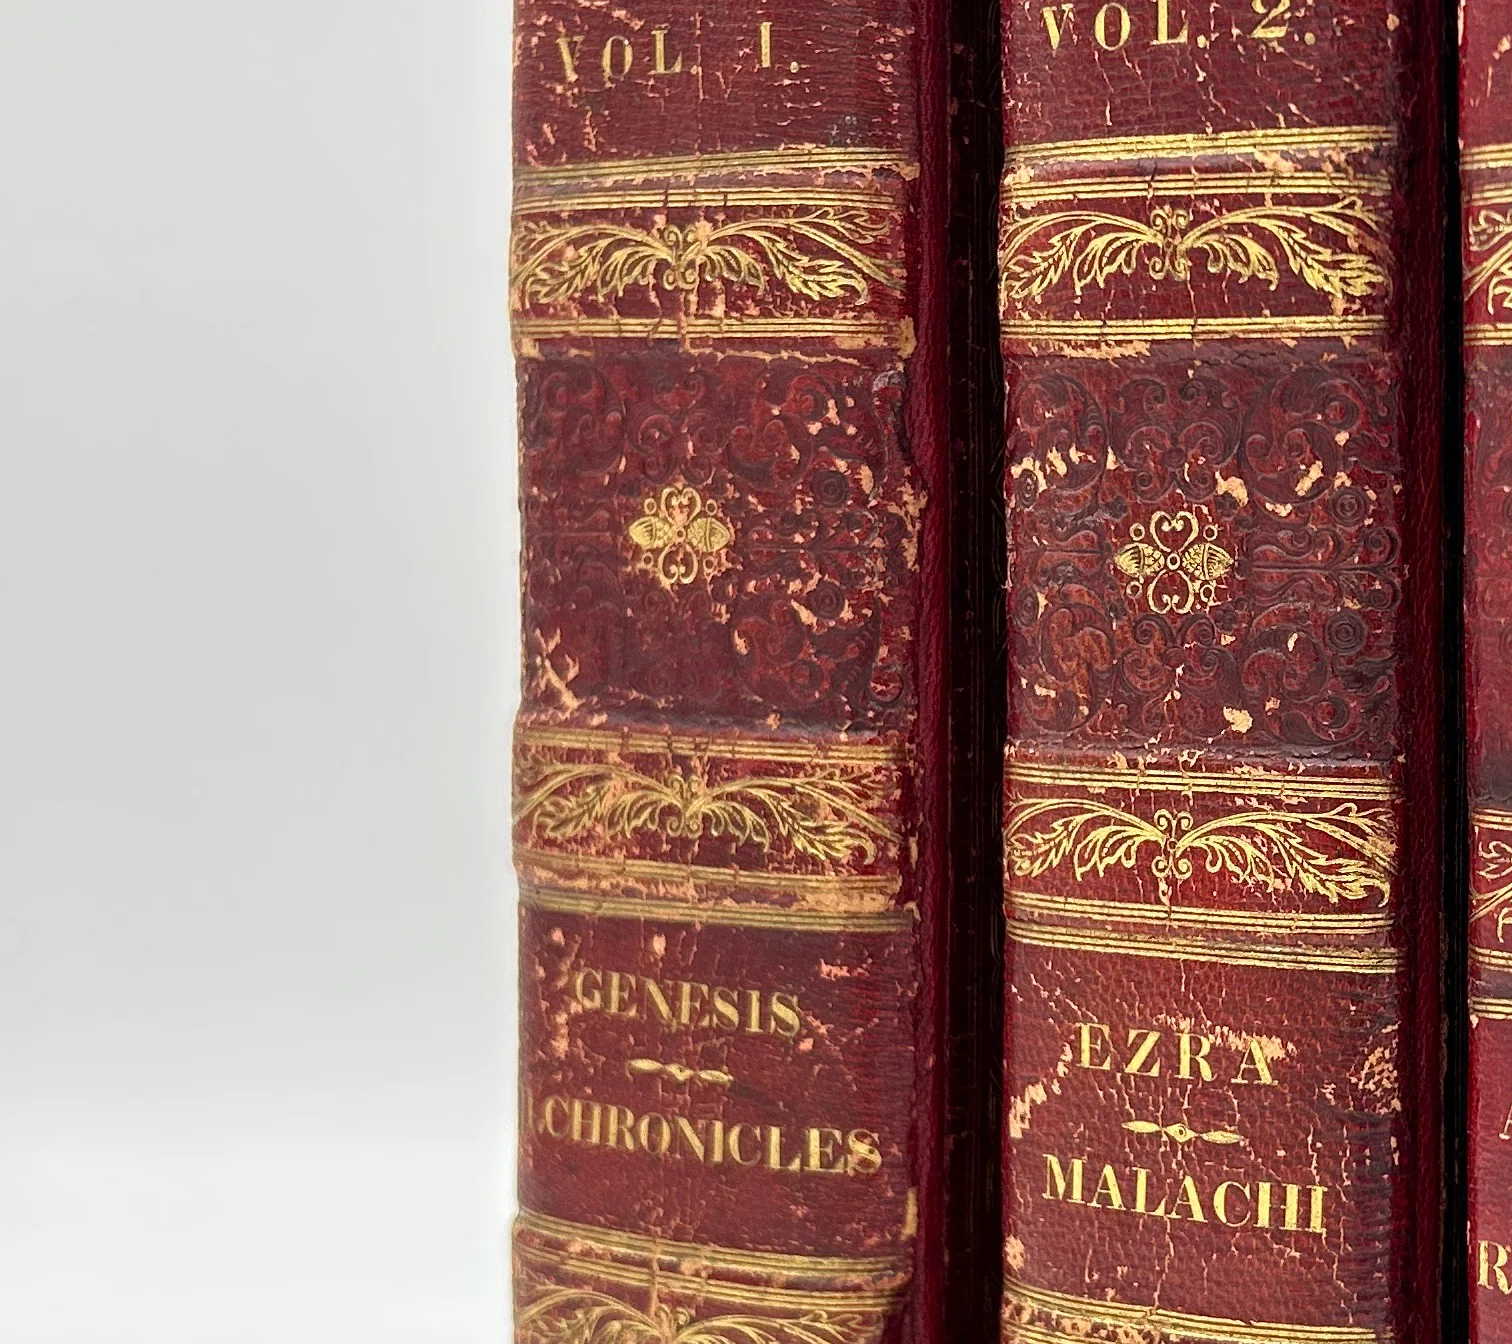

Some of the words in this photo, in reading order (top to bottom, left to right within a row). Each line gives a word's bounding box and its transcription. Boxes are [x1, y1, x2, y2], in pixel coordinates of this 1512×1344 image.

[1041, 0, 1209, 56] VOL.
[573, 966, 801, 1038] GENESIS
[1075, 1022, 1279, 1086] EZRA
[1041, 1153, 1328, 1233] MALACHI
